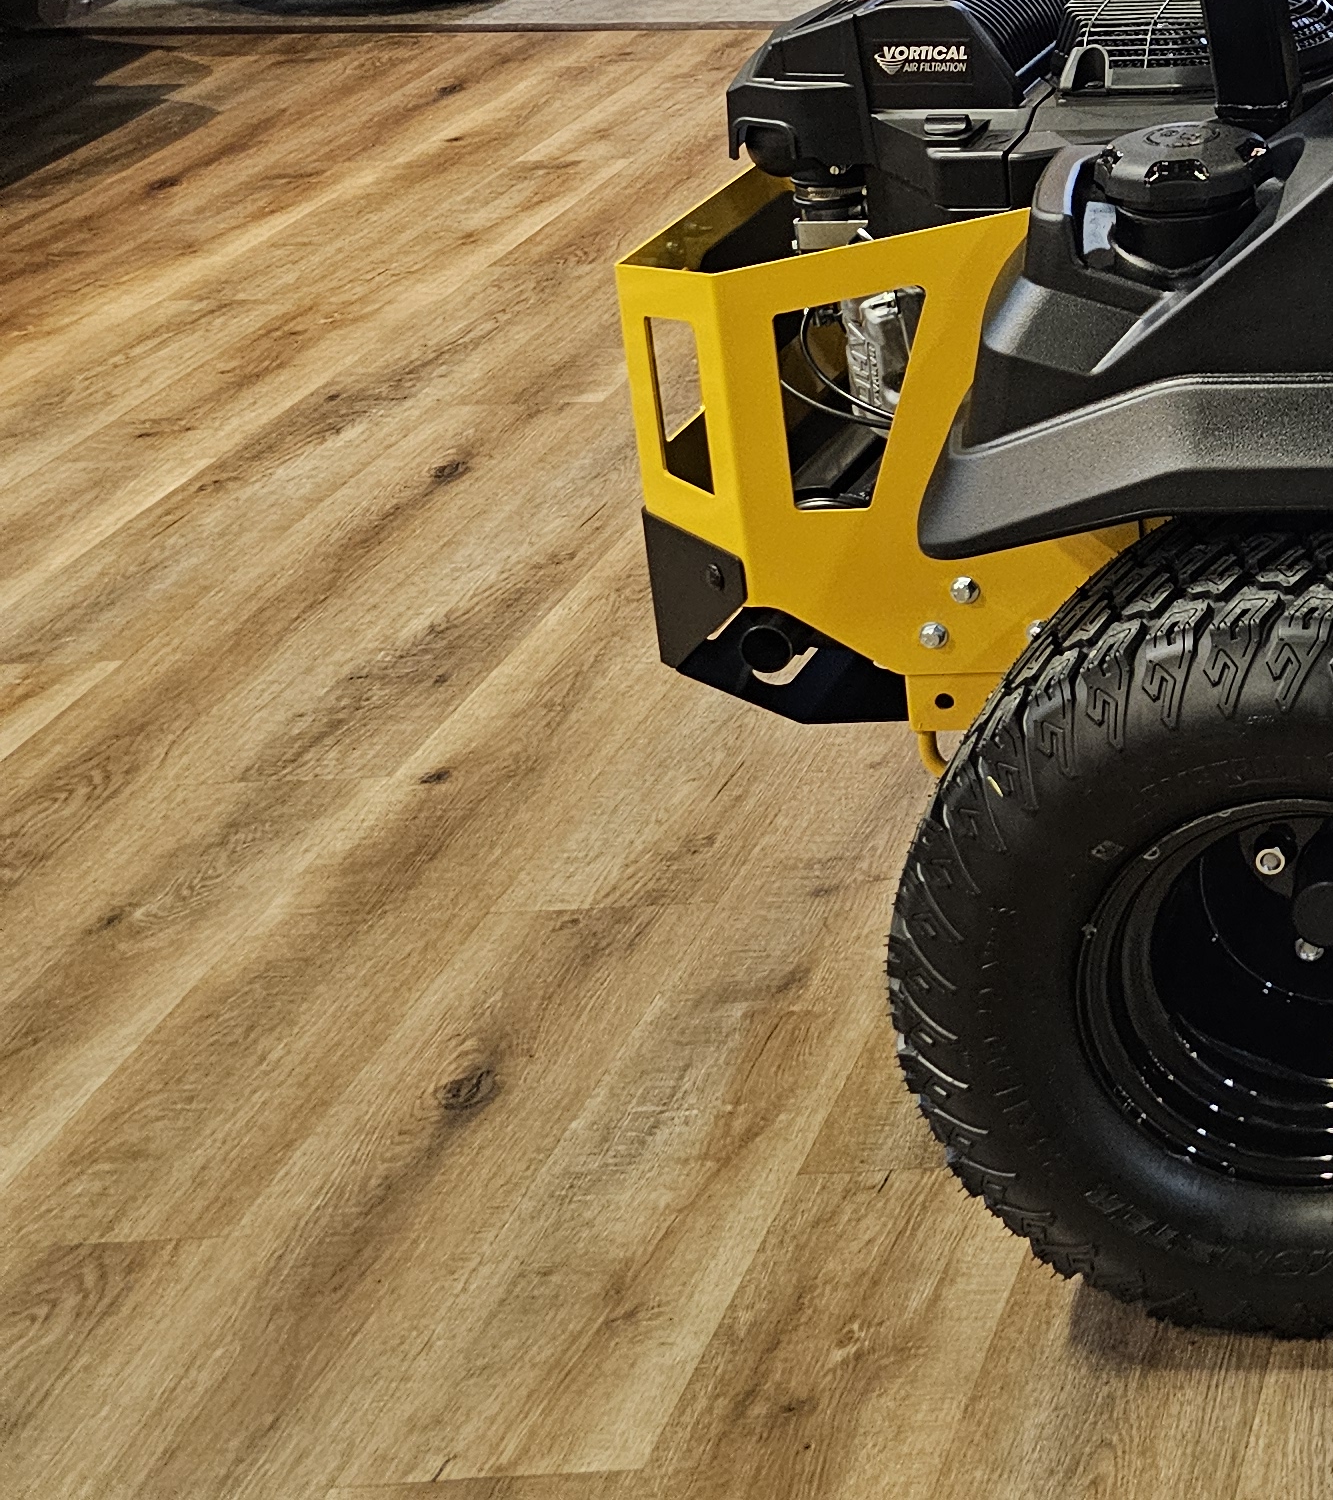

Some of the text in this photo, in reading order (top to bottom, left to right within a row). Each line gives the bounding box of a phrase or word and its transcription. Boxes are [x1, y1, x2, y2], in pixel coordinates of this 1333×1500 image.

[883, 45, 968, 61] VORTICAL
[902, 61, 967, 73] AIR FILTRATION
